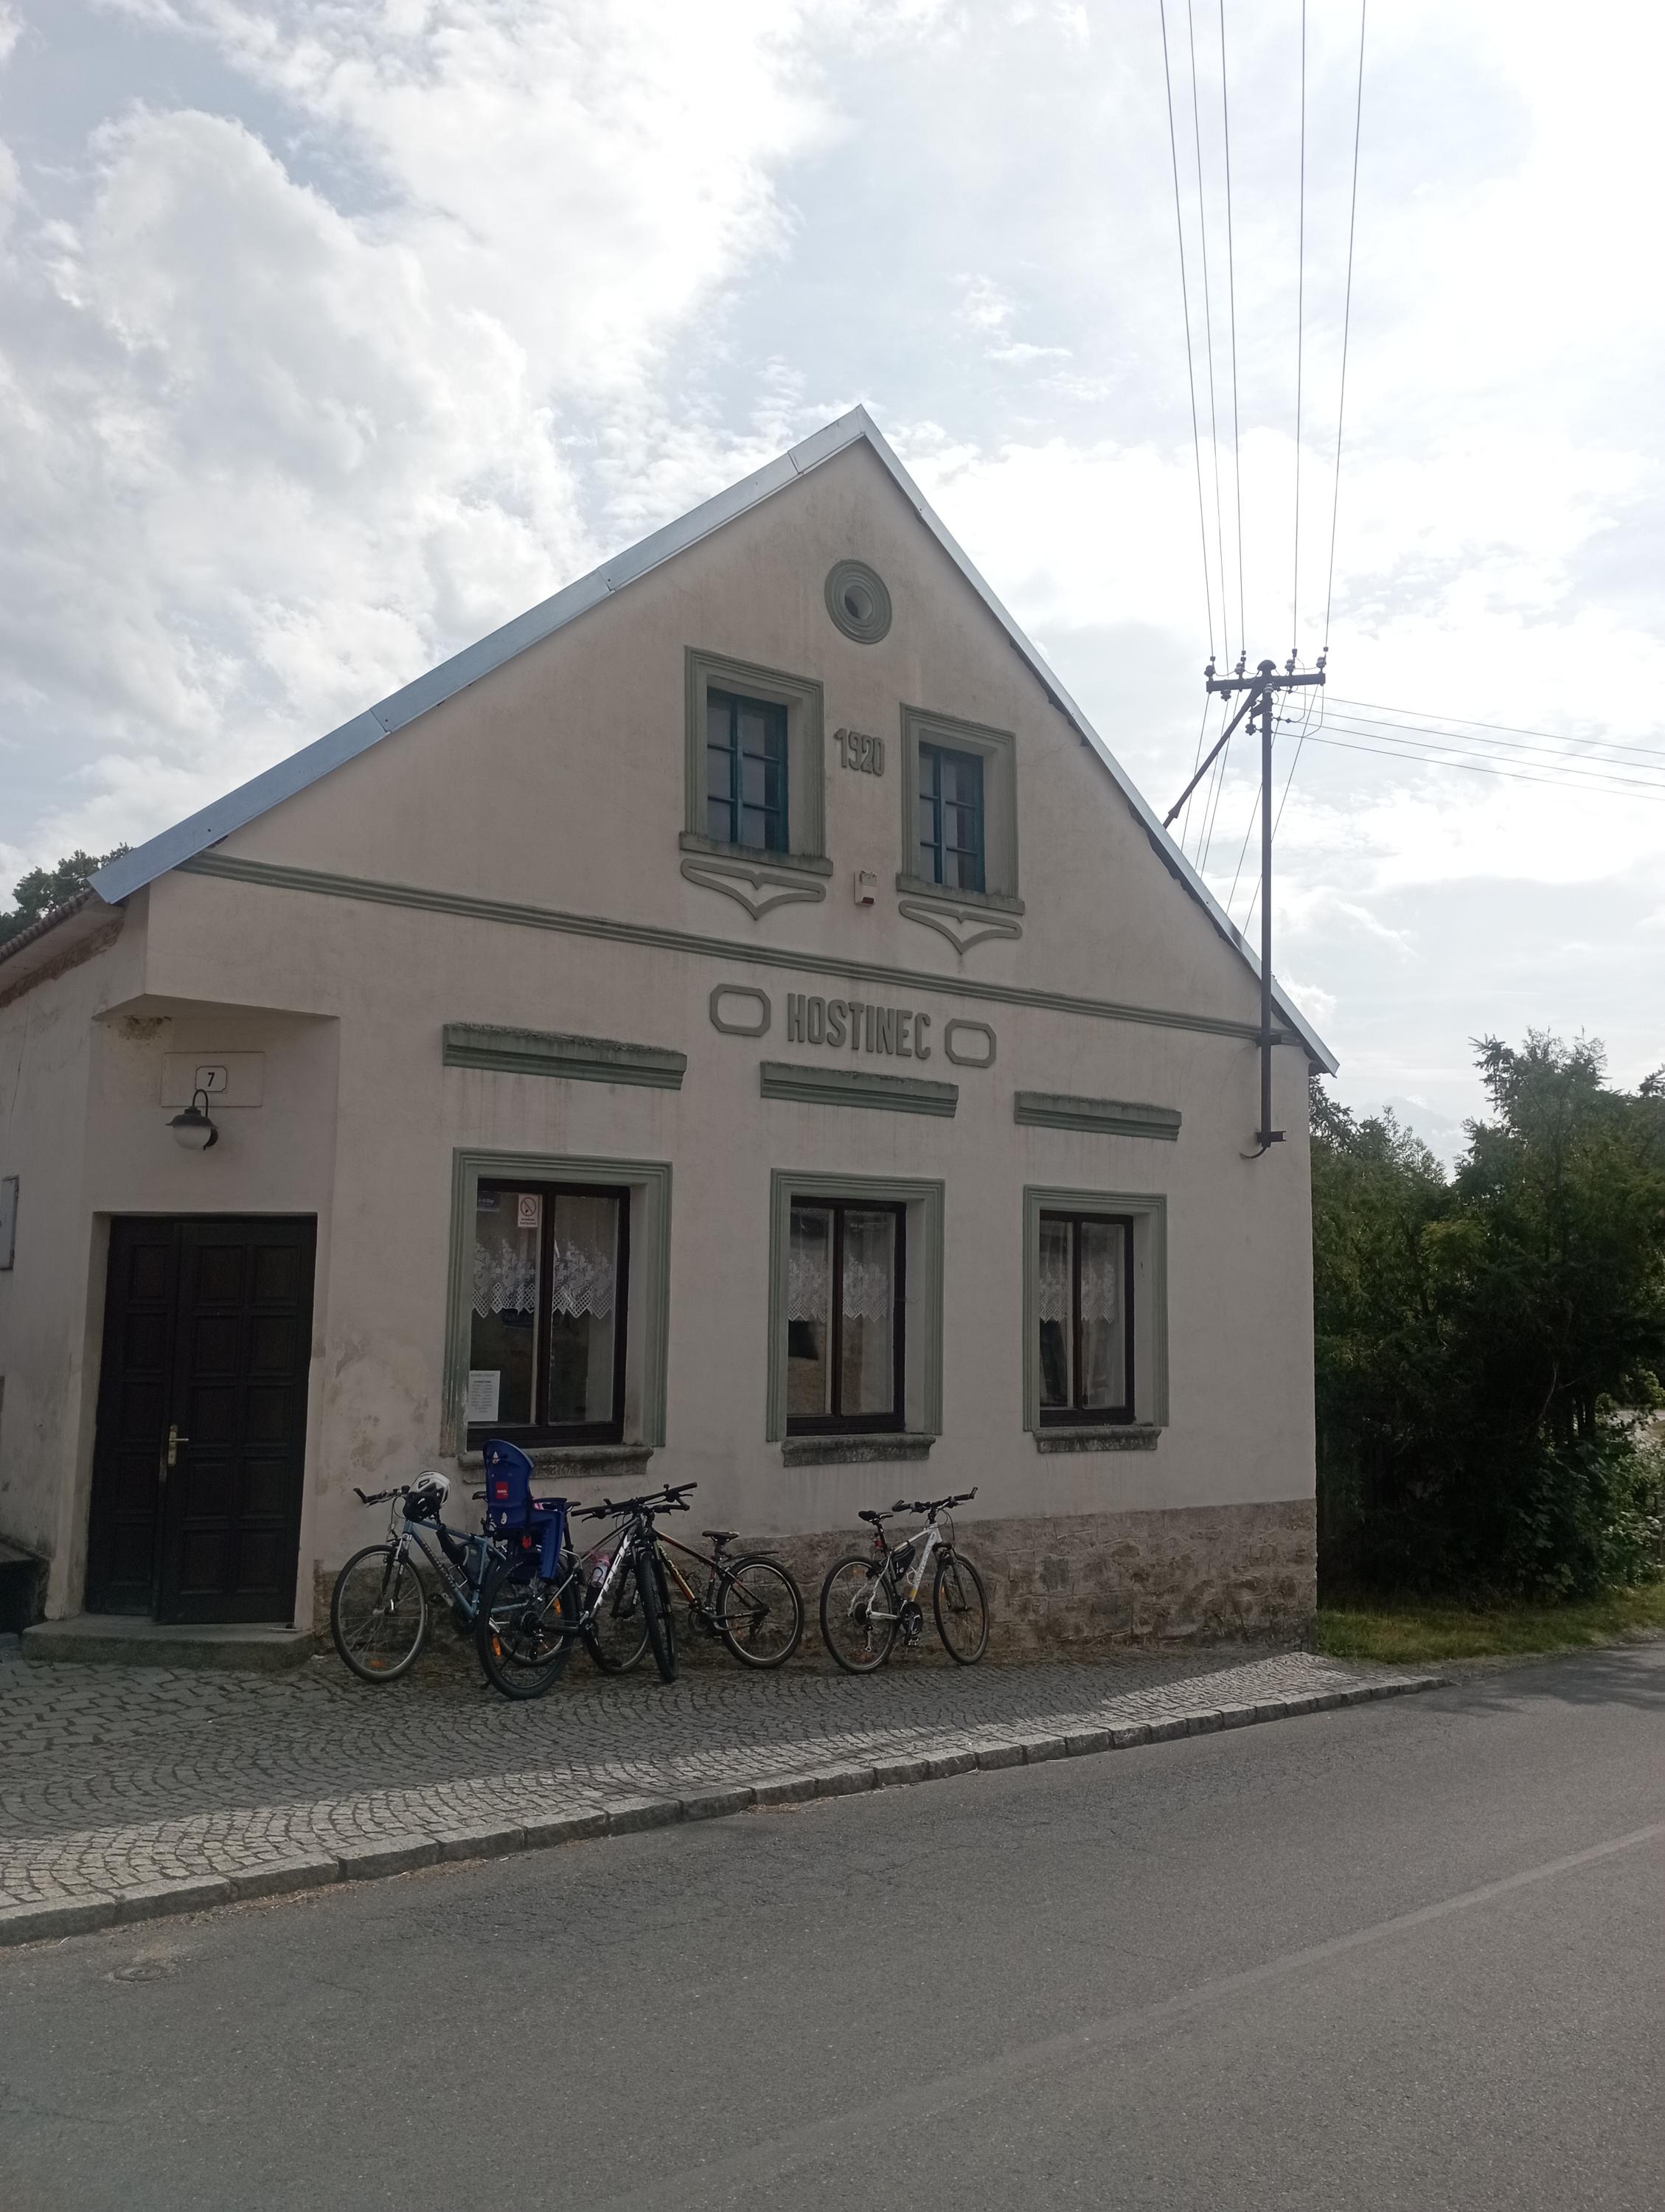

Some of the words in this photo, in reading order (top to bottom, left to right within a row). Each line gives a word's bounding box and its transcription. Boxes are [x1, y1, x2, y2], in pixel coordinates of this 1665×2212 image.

[833, 728, 885, 776] 1920
[788, 992, 931, 1059] HOSTINEC
[207, 1072, 215, 1087] 7
[594, 1534, 630, 1609] TREK
